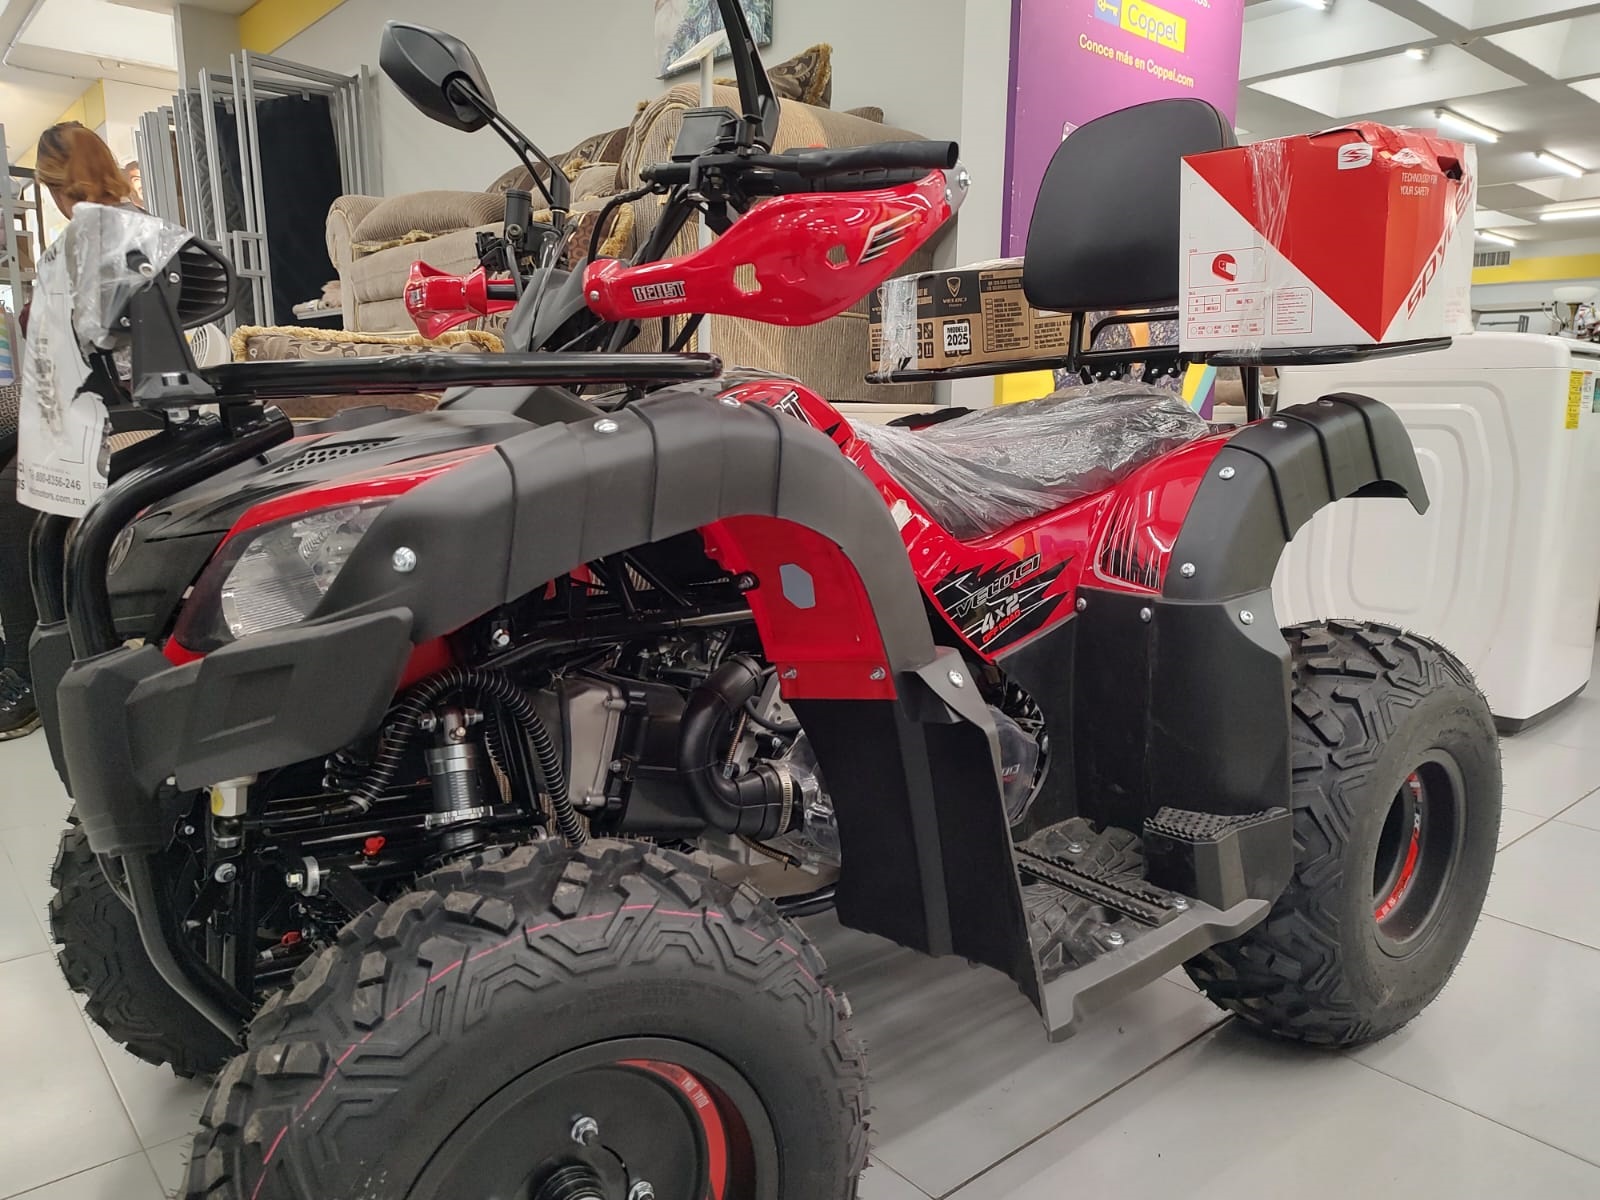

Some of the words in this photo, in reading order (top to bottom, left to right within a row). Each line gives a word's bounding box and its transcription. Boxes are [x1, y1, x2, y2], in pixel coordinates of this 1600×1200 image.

[1127, 4, 1179, 44] Coppel
[1079, 33, 1114, 58] Conoce
[1116, 50, 1134, 66] más
[1134, 58, 1146, 70] en
[1146, 58, 1195, 88] Coppel.com
[946, 333, 969, 347] 2025
[982, 625, 999, 643] OFF
[998, 609, 1022, 631] ROAD
